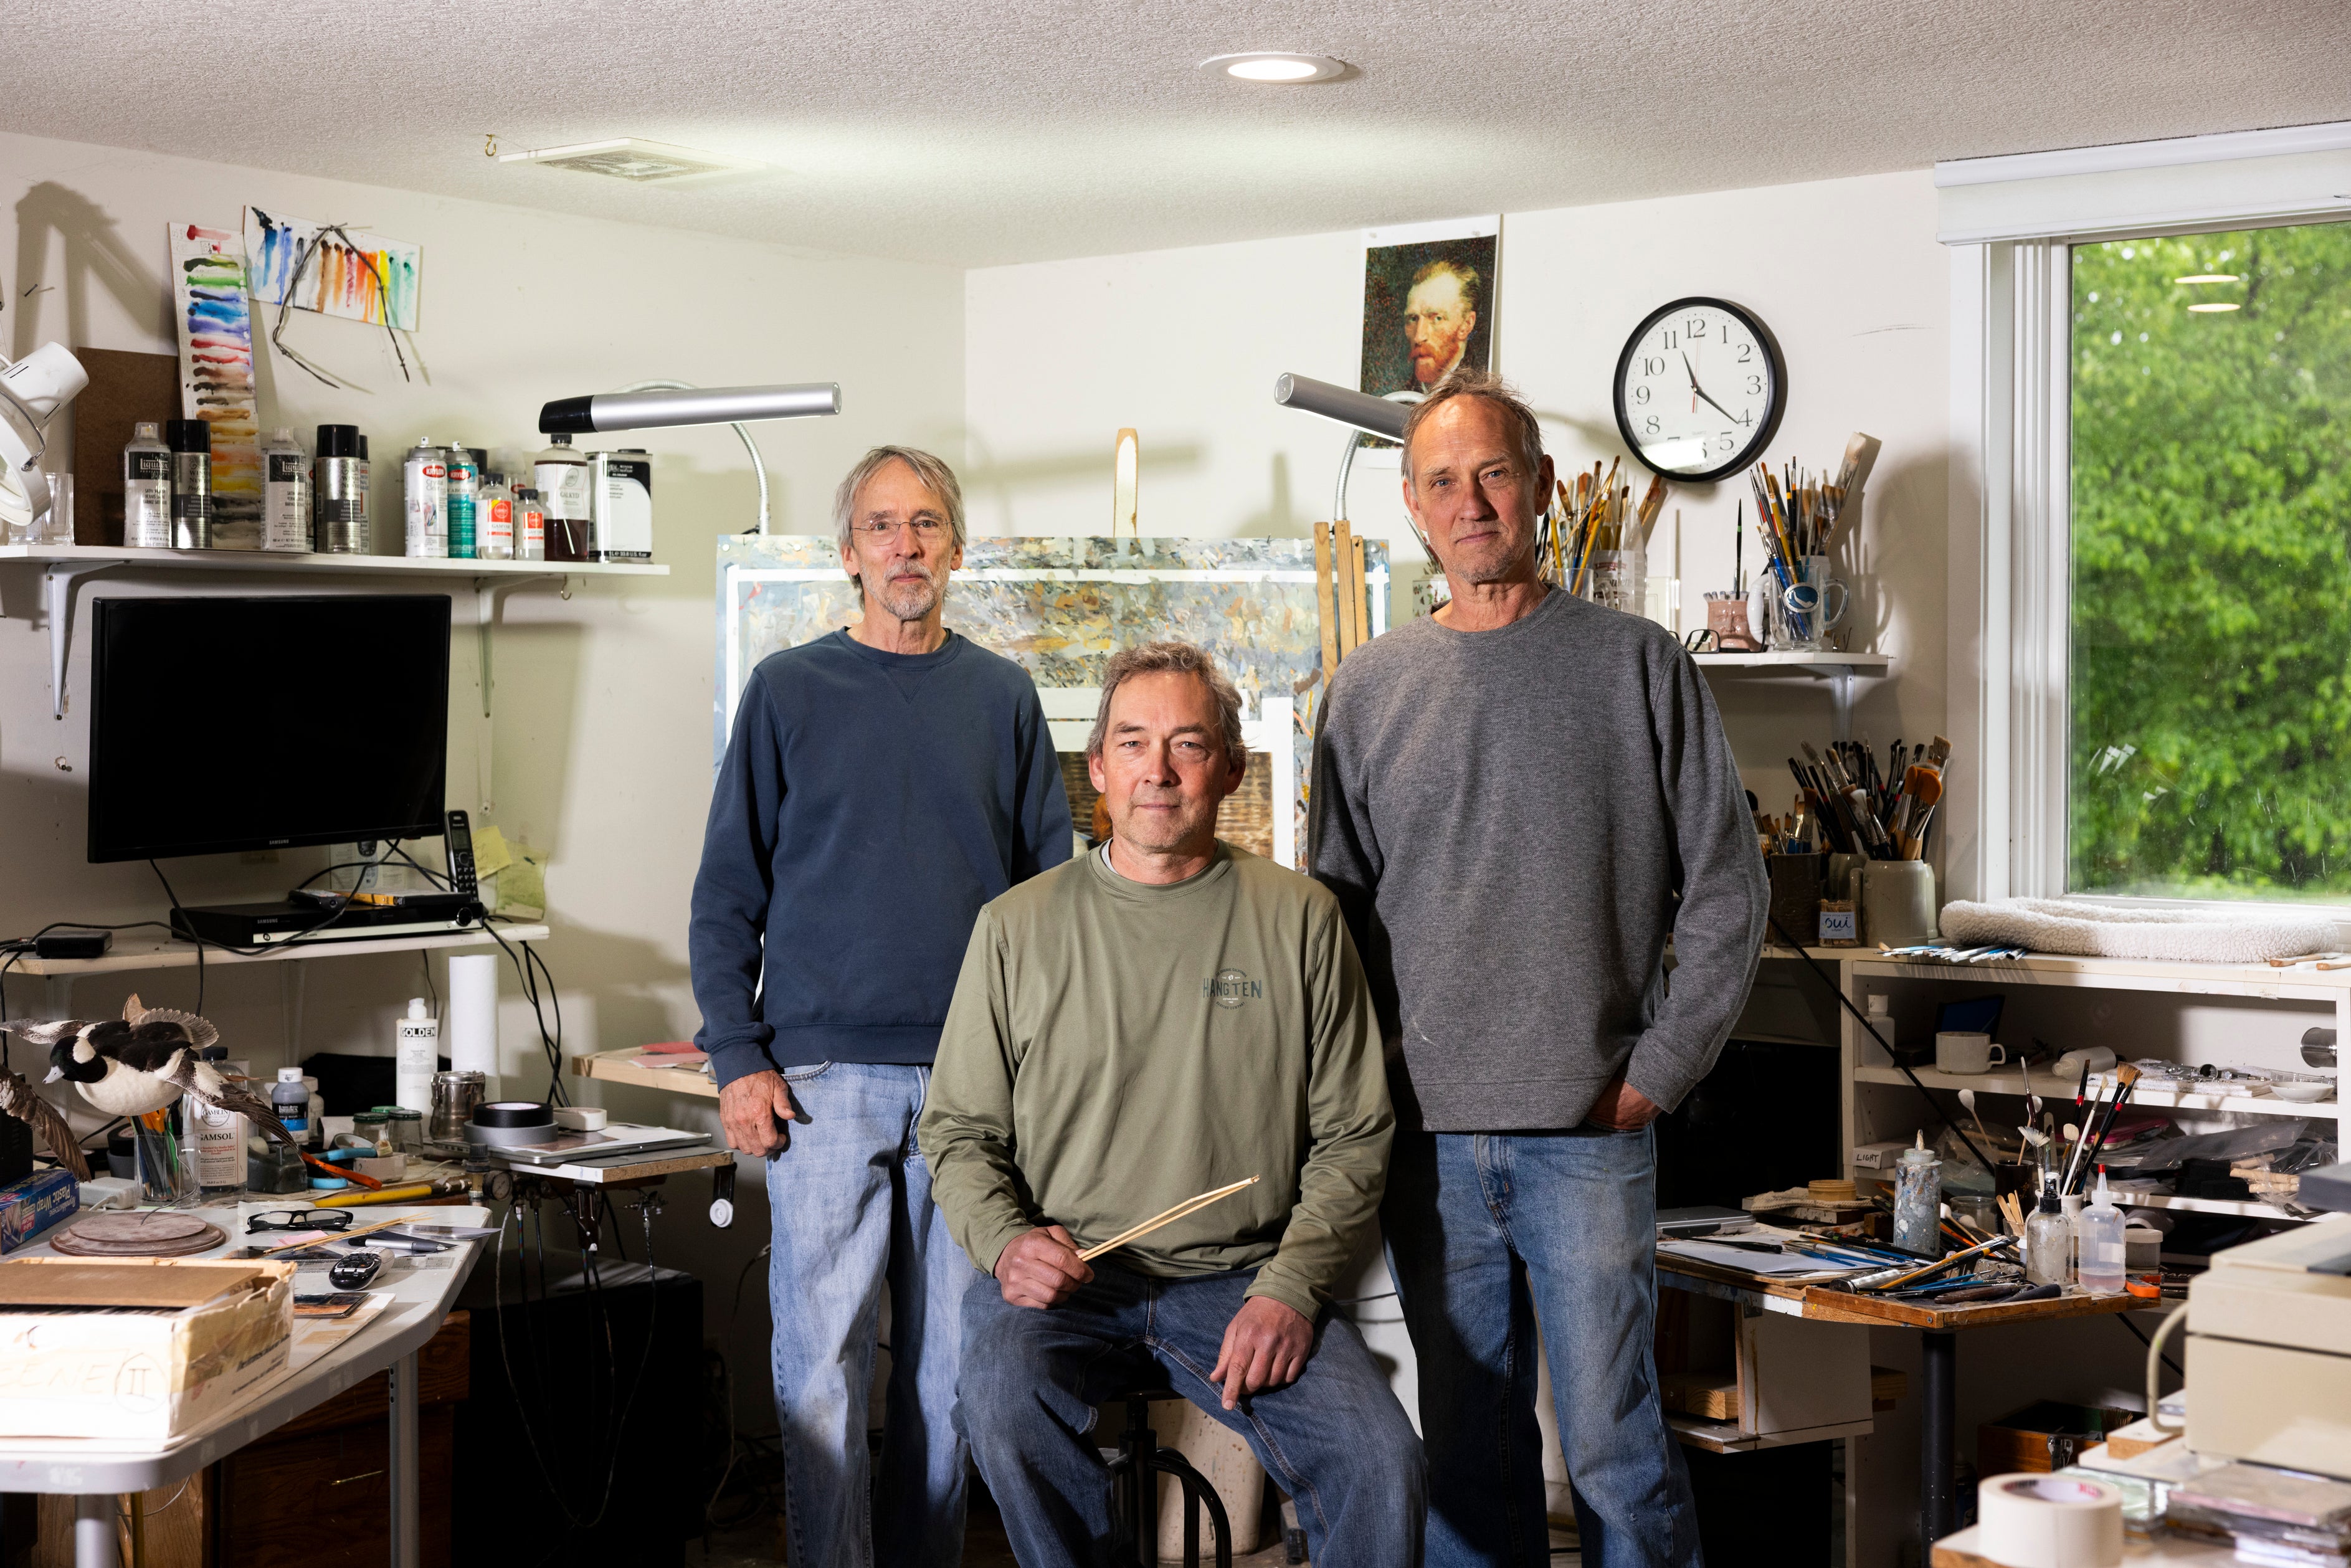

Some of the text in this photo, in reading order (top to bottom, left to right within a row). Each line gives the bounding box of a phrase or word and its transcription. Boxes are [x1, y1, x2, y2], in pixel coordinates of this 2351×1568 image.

[1686, 318, 1706, 340] 12
[1722, 325, 1728, 344] 1
[1663, 330, 1678, 350] 11
[1737, 343, 1752, 364] 2
[1643, 356, 1665, 376] 10
[1636, 385, 1651, 405] 9
[1746, 374, 1762, 396] 3
[1646, 415, 1661, 435] 8
[1737, 407, 1754, 428] 4
[1719, 431, 1734, 451] 5
[1825, 916, 1852, 928] oui
[1203, 977, 1262, 999] HANG TEN
[401, 1027, 435, 1037] GOLDEN
[1856, 1153, 1879, 1163] LIGHT
[37, 1195, 52, 1212] Wrap
[52, 1184, 70, 1205] Plastic
